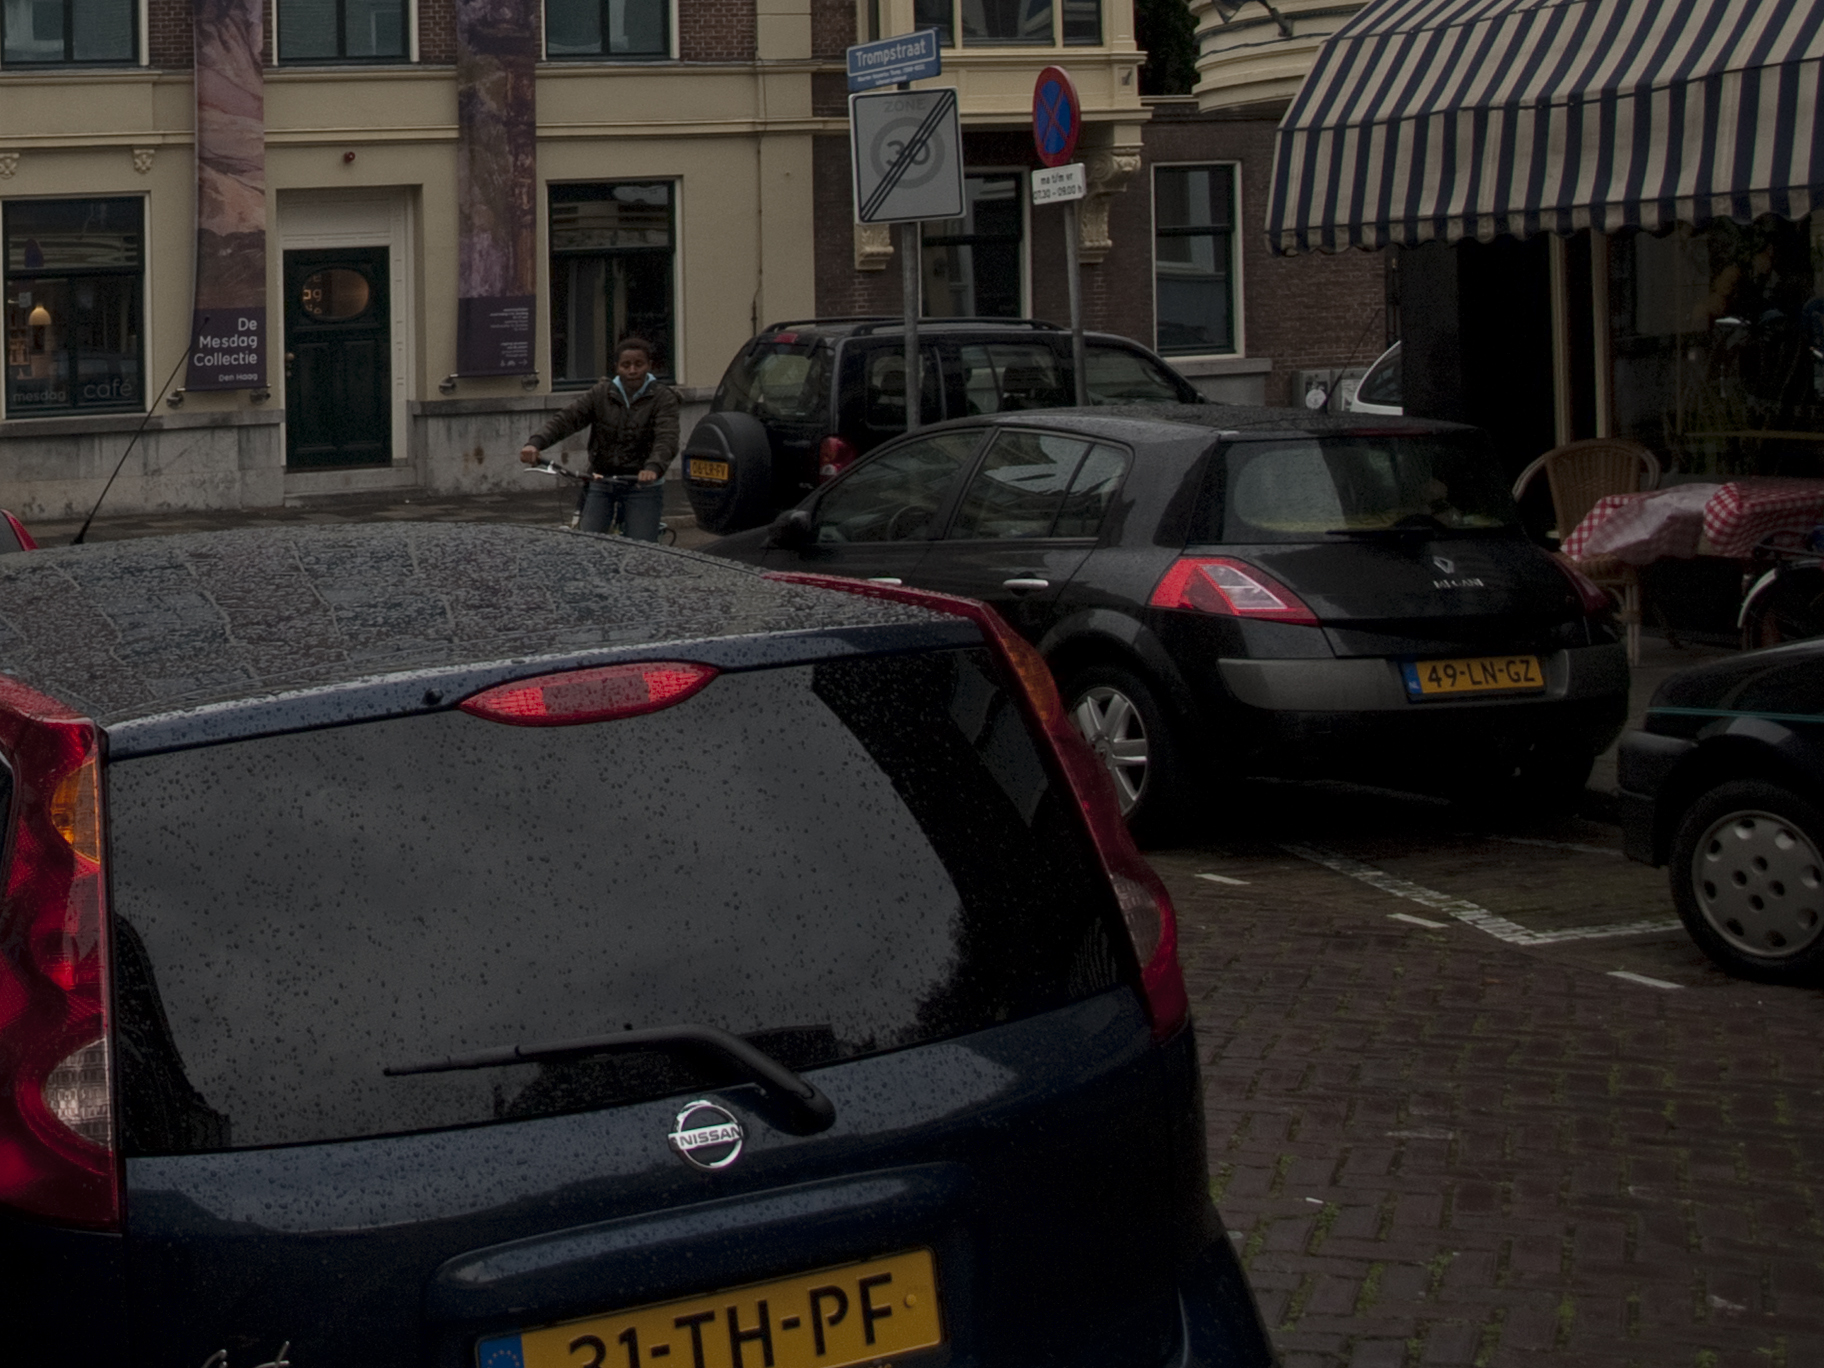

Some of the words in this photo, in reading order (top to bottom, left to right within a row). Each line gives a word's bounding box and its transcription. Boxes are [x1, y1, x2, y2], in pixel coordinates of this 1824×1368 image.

[856, 38, 926, 67] Trompstraat
[883, 98, 928, 113] ZONE
[238, 317, 258, 331] De
[199, 333, 258, 349] Mesdag
[193, 350, 258, 367] Collectie
[218, 374, 235, 382] Den
[236, 373, 258, 381] Haag
[13, 389, 68, 402] mesdag
[83, 377, 133, 399] café
[1427, 659, 1536, 688] 49-LN-GZ
[679, 1126, 742, 1147] NISSAN
